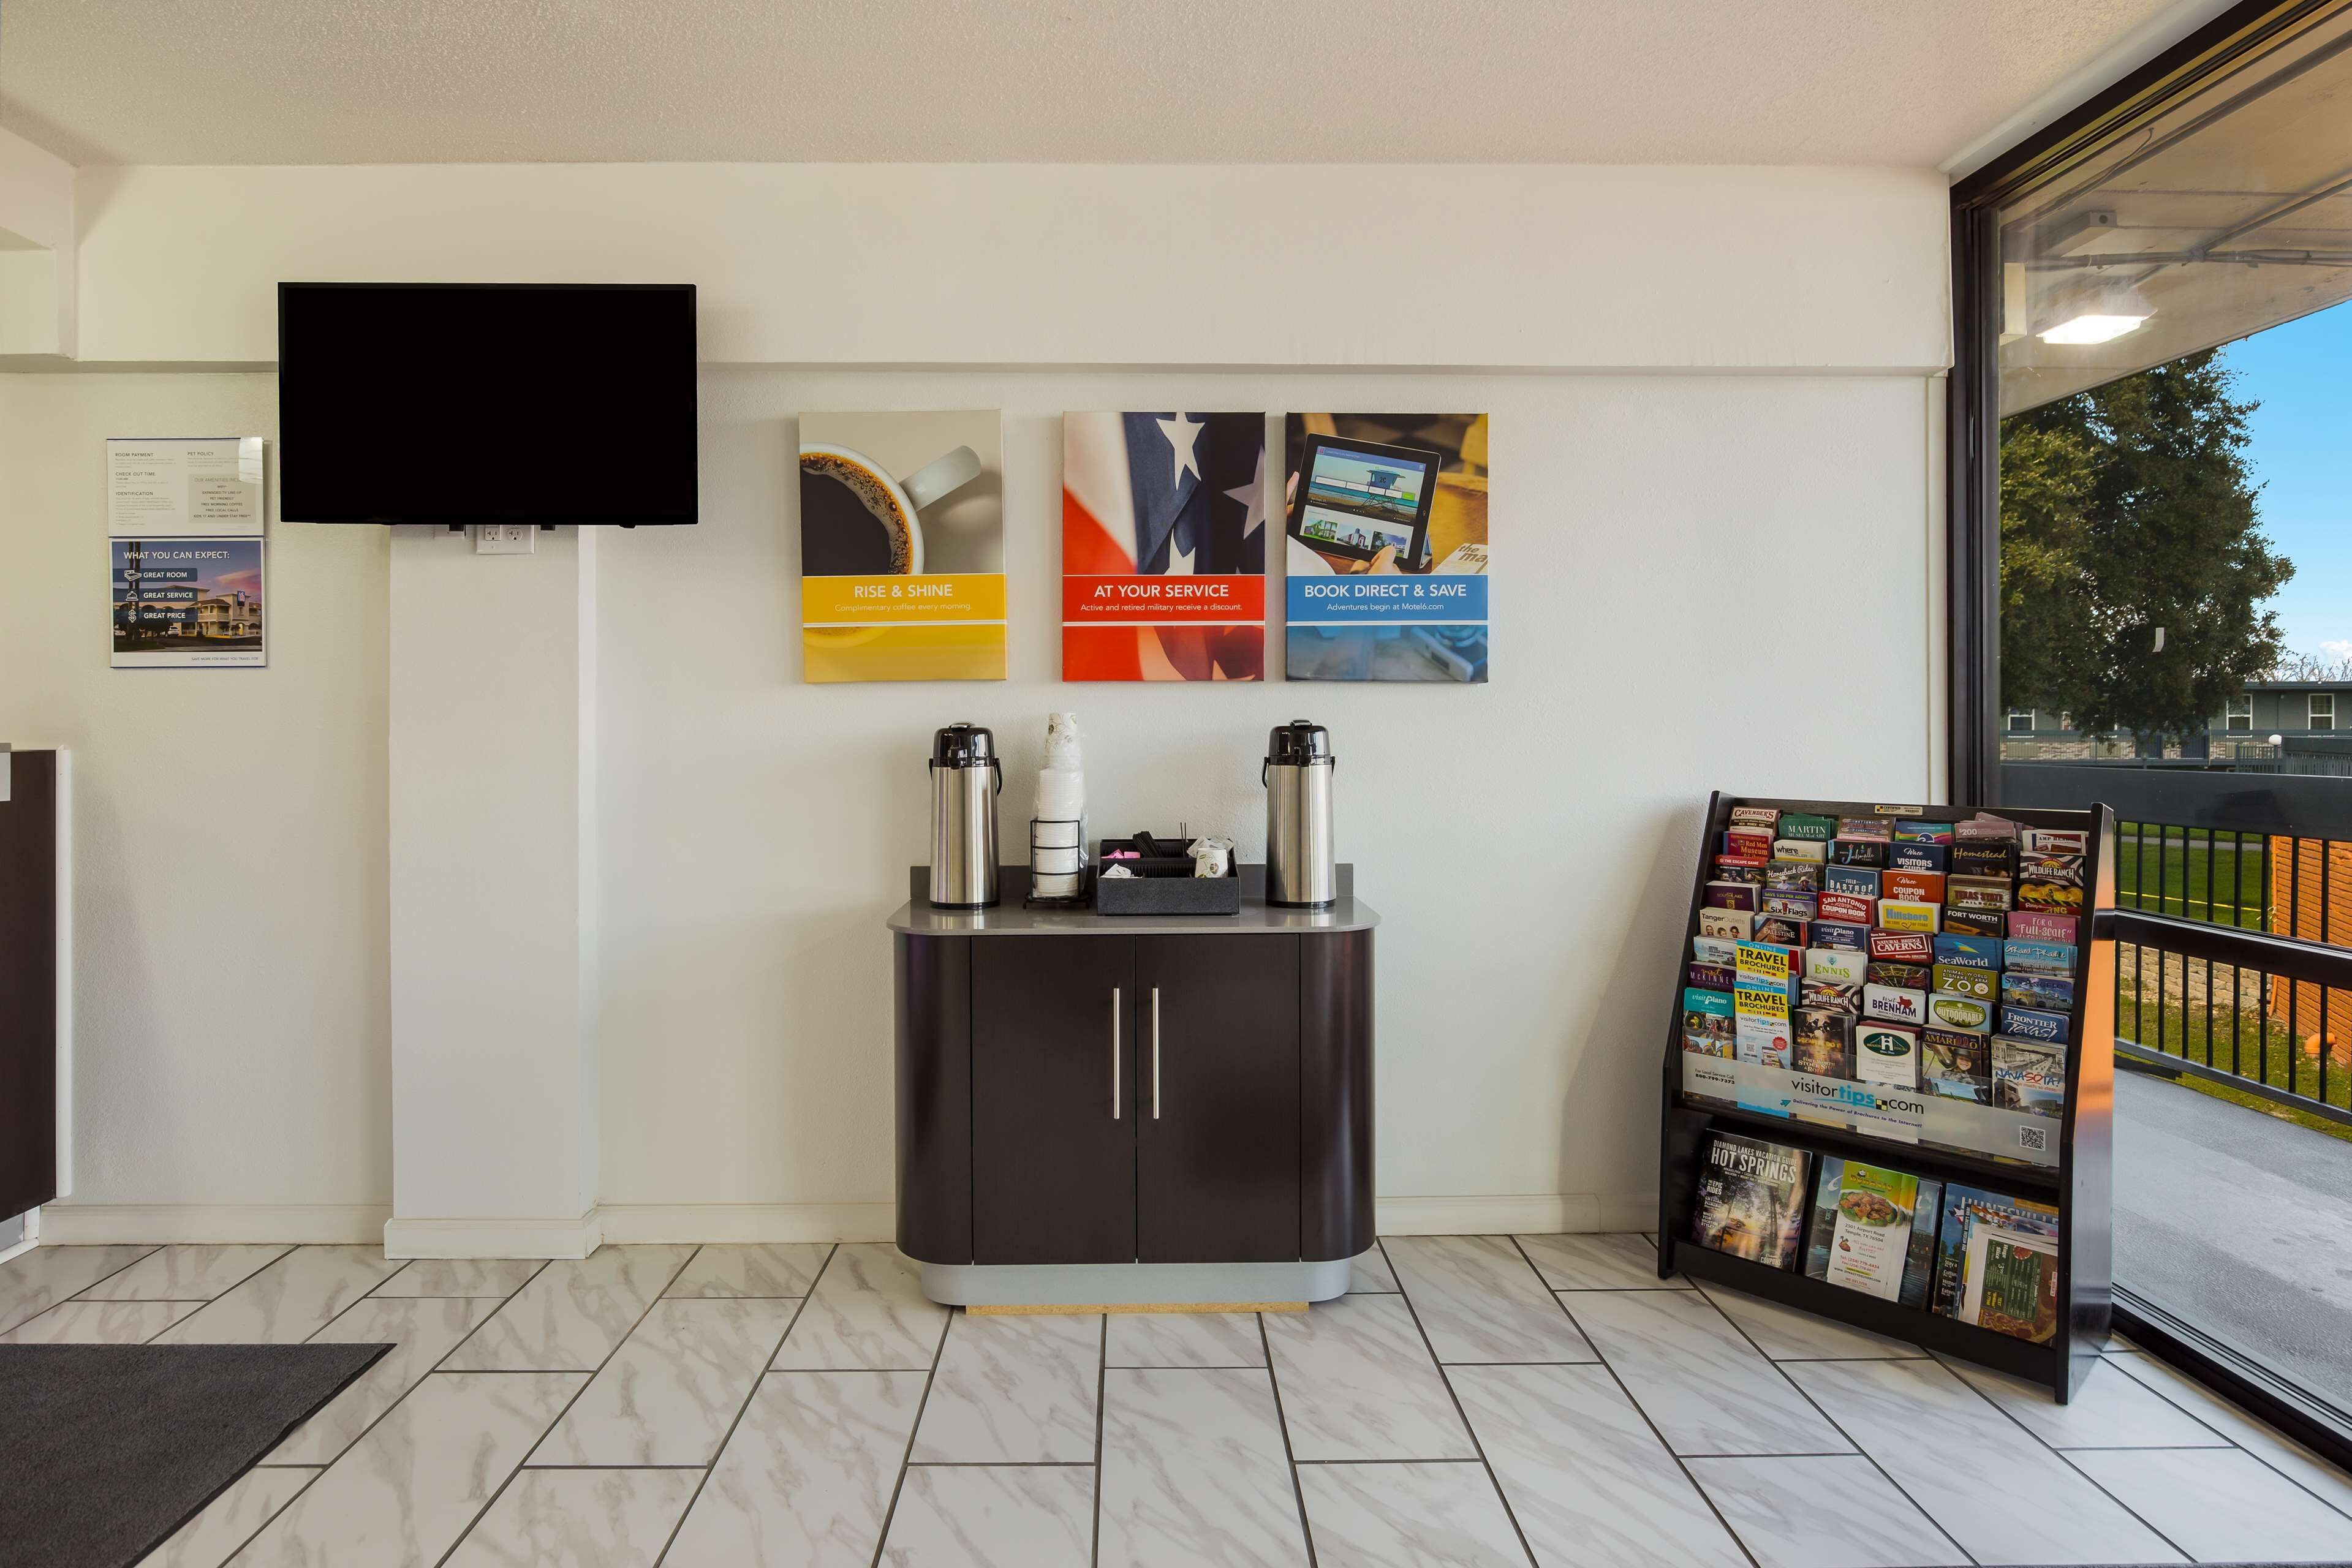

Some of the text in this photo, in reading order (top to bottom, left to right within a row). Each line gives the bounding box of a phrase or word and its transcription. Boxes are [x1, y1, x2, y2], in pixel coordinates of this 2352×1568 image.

[854, 584, 953, 598] RISE & SHINE
[1094, 584, 1229, 597] AT YOUR SERVICE
[1304, 584, 1467, 597] BOOK DIRECT & SAVE
[834, 604, 891, 612] Complimentary
[1147, 603, 1173, 612] military
[1370, 603, 1390, 612] begin
[1734, 809, 1775, 820] CAVENDER'S
[1788, 825, 1826, 834] MARTIN
[1741, 846, 1768, 855] Museum
[1775, 845, 1799, 854] where
[1903, 847, 1924, 856] Waco
[1953, 847, 2007, 859] Homestead
[1897, 858, 1933, 867] VISITORS
[1767, 864, 1814, 878] Horseback Rides
[2029, 864, 2053, 875] WILDLIFE
[2053, 867, 2074, 880] RANCH
[1829, 880, 1874, 892] BASTROP
[1896, 876, 1918, 884] Waco
[1893, 886, 1926, 895] COUPON
[1954, 889, 2005, 902] TEXAS STATE
[1837, 897, 1867, 911] ANTONIO
[1788, 907, 1808, 916] Flags
[1821, 905, 1848, 914] COUPON
[1848, 908, 1866, 918] BOOK
[1885, 908, 1929, 921] Hillsboro
[1947, 910, 1998, 922] FORT WORTH
[2032, 918, 2048, 926] FOR
[1763, 927, 1795, 938] PALESTINE
[1749, 942, 1777, 952] ONLINE
[1877, 942, 1924, 952] CAVERNS
[1739, 948, 1787, 967] TRAVEL
[1938, 956, 1988, 967] SeaWorld
[1739, 959, 1785, 973] BROCHURES
[1814, 963, 1850, 978] ENNIS
[1746, 984, 1775, 993] ONLINE
[1736, 990, 1785, 1006] TRAVEL
[1809, 992, 1830, 1003] WILDLIFE
[1830, 995, 1849, 1008] RANCH
[1739, 1001, 1785, 1012] BROCHURES
[1872, 999, 1916, 1017] BRENHAM
[1937, 1008, 1984, 1022] OUTDOORABLE
[2008, 1012, 2057, 1029] FRONTIER
[2004, 1020, 2058, 1041] Texas!
[1798, 1060, 1819, 1069] STOCK
[1695, 1073, 1735, 1085] 800-799-7373
[1995, 1068, 2062, 1087] NAVASOTA!
[1793, 1098, 1818, 1108] Delivering
[1854, 1110, 1880, 1121] Brochures
[1898, 1119, 1923, 1128] Internet!
[1714, 1140, 1797, 1166] DIAMOND LAKES VACATION GUIDE
[1711, 1147, 1797, 1184] HOT SPRINGS
[1707, 1185, 1722, 1195] RIDES
[1712, 1180, 1723, 1189] EPIC
[1844, 1229, 1862, 1238] Temple,
[1869, 1234, 1884, 1243] 76504
[1856, 1225, 1872, 1235] Airport
[1873, 1229, 1885, 1238] Road
[1760, 1256, 1782, 1266] COUPONS
